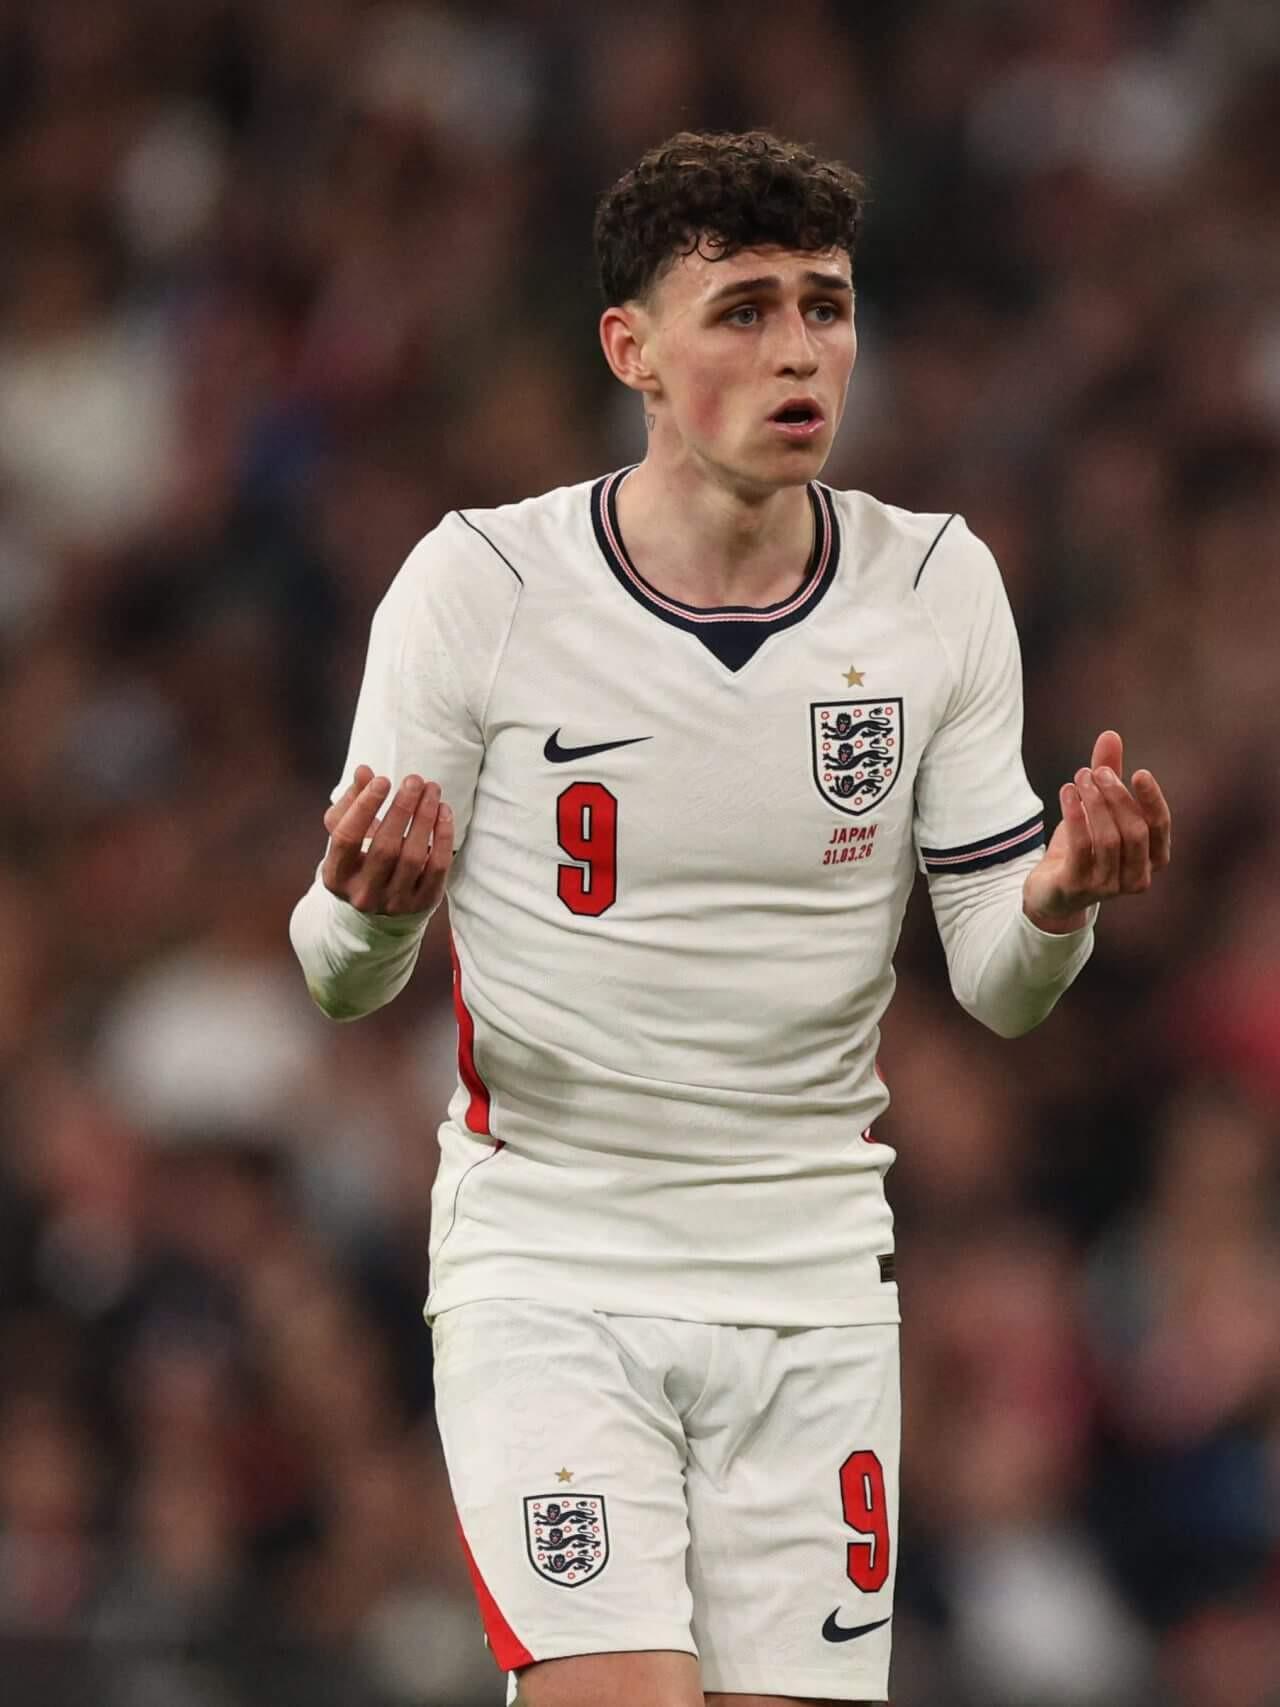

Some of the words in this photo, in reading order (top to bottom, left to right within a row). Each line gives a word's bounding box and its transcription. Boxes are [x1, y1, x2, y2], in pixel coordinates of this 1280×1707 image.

[556, 781, 618, 917] 9
[822, 842, 873, 865] 31.03.26
[829, 824, 878, 844] JAPAN
[839, 1450, 890, 1593] 9
